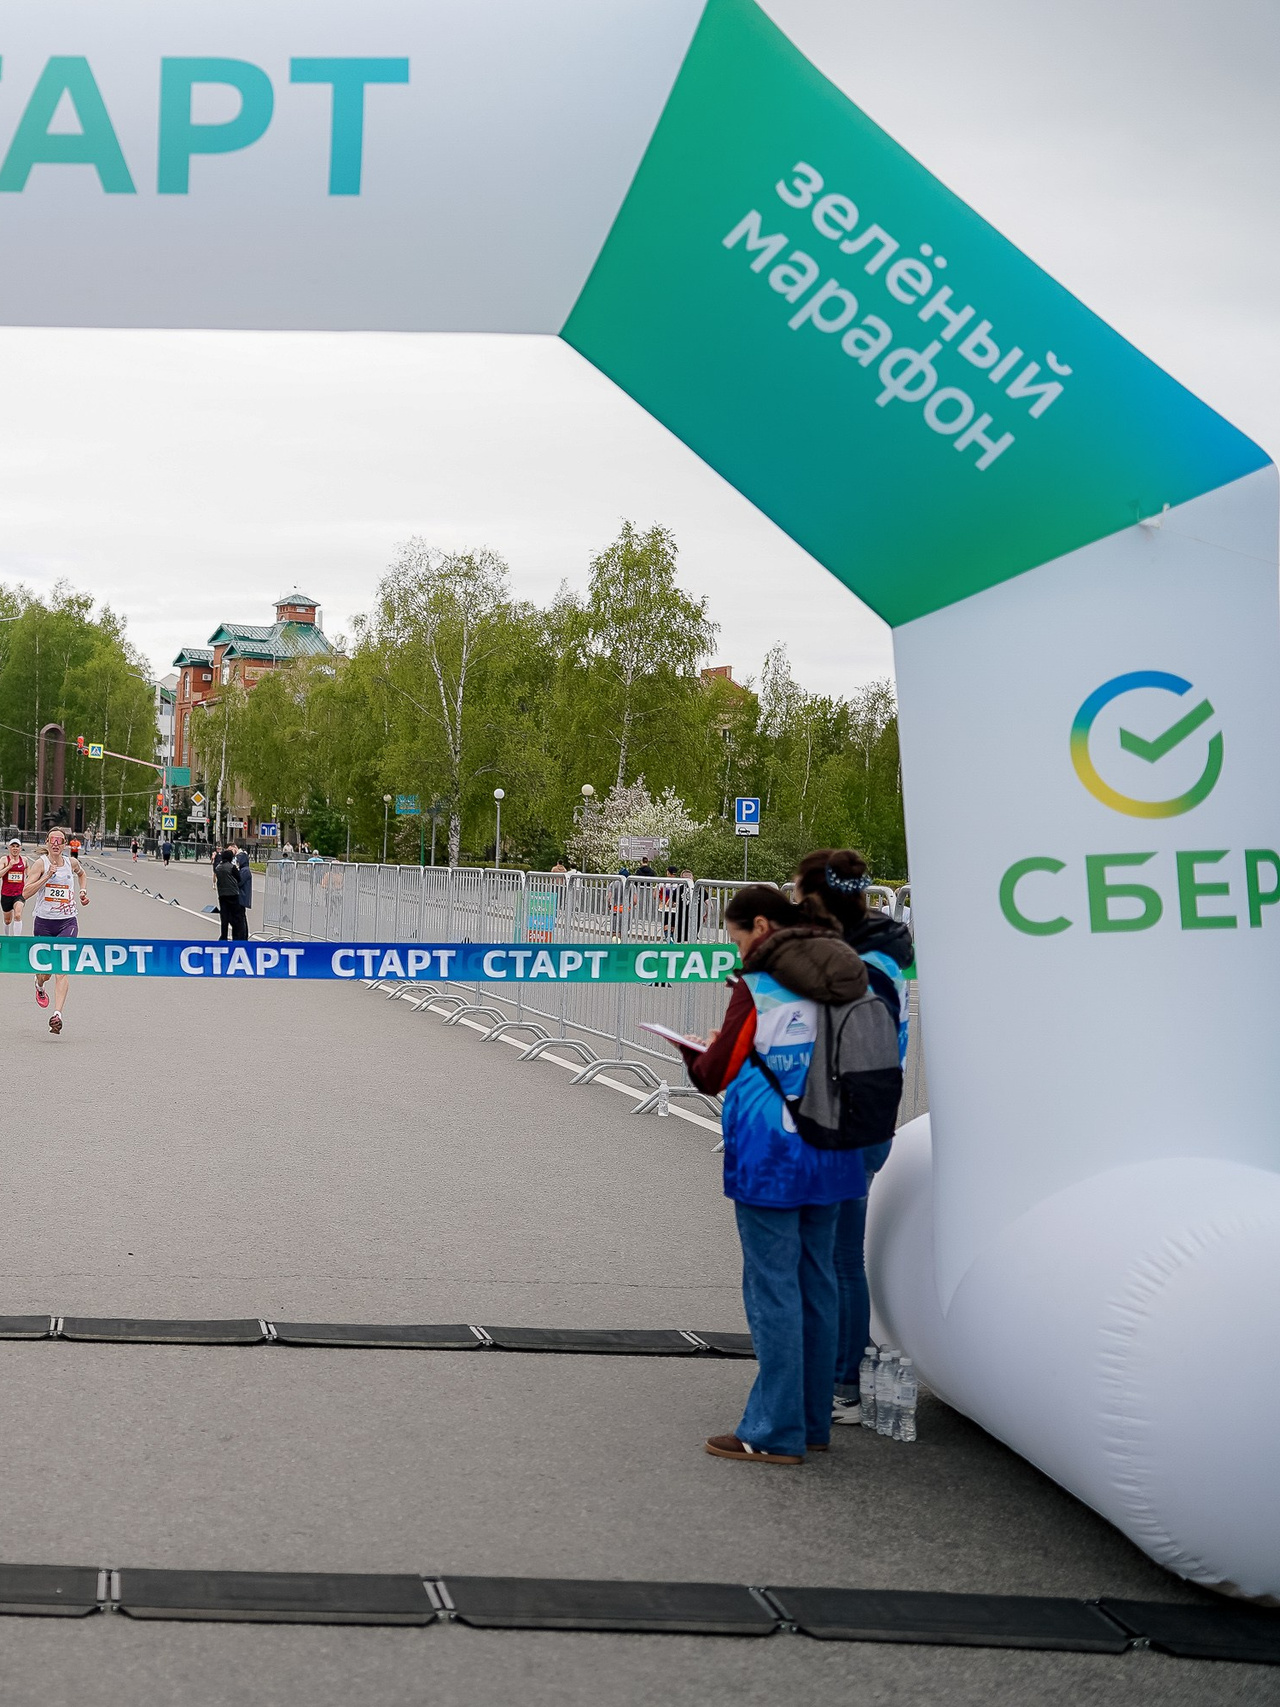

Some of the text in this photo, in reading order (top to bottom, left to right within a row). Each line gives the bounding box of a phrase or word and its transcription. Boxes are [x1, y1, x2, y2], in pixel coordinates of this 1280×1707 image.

[775, 161, 1073, 419] зелёный
[722, 209, 1015, 471] марафон
[742, 801, 756, 821] P
[50, 889, 65, 897] 282
[999, 848, 1280, 936] СБЕР
[28, 943, 153, 973] СТАРТ
[180, 946, 305, 976] СТАРТ
[331, 949, 456, 978] СТАРТ
[483, 950, 608, 979] СТАРТ
[635, 950, 741, 979] СТАР
